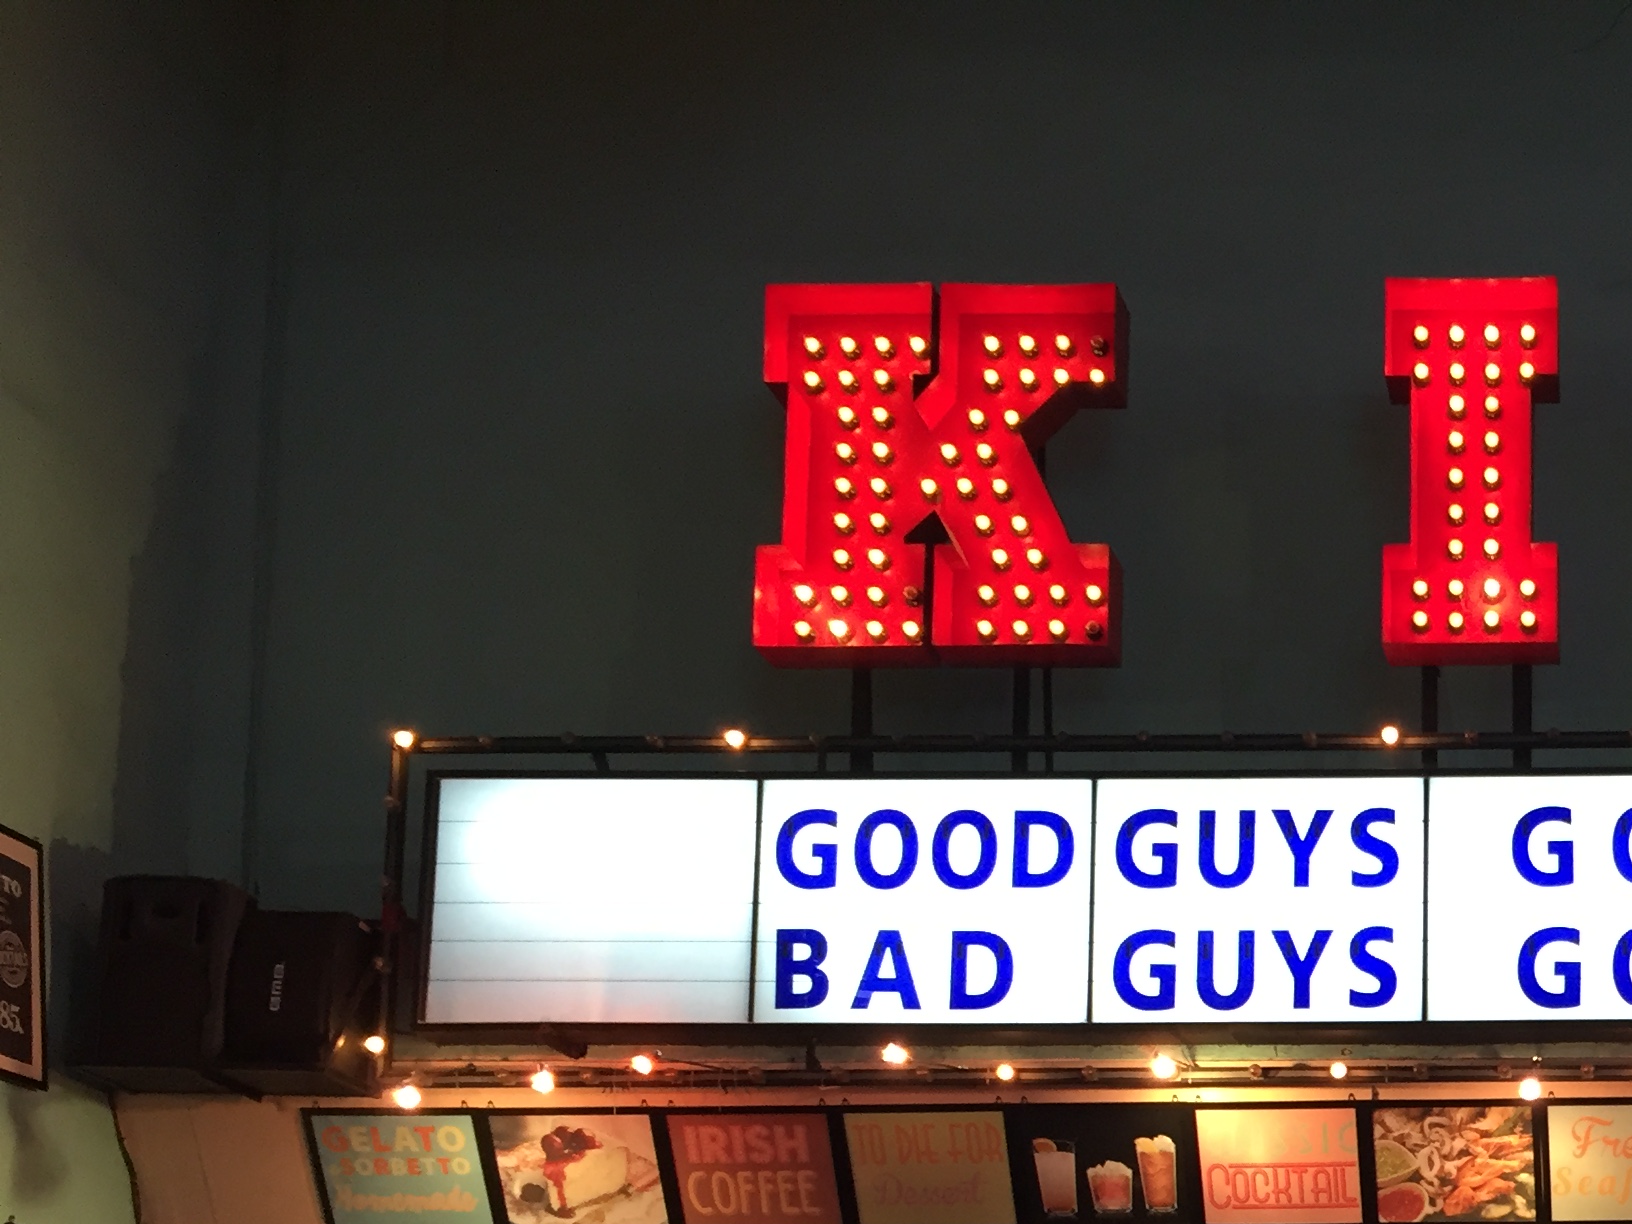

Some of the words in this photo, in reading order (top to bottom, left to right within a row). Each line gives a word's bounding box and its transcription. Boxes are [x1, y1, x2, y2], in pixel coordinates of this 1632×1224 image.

[776, 809, 1075, 889] GOOD
[1116, 808, 1399, 888] GUYS
[775, 929, 1013, 1010] BAD
[1113, 926, 1397, 1011] GUYS
[322, 1125, 466, 1152] GELATO
[683, 1124, 809, 1164] IRISH
[851, 1123, 886, 1165] TO
[894, 1122, 939, 1165] DIE
[948, 1121, 1004, 1164] FOR
[339, 1156, 471, 1176] SORBETTO
[687, 1169, 820, 1215] COFFEE
